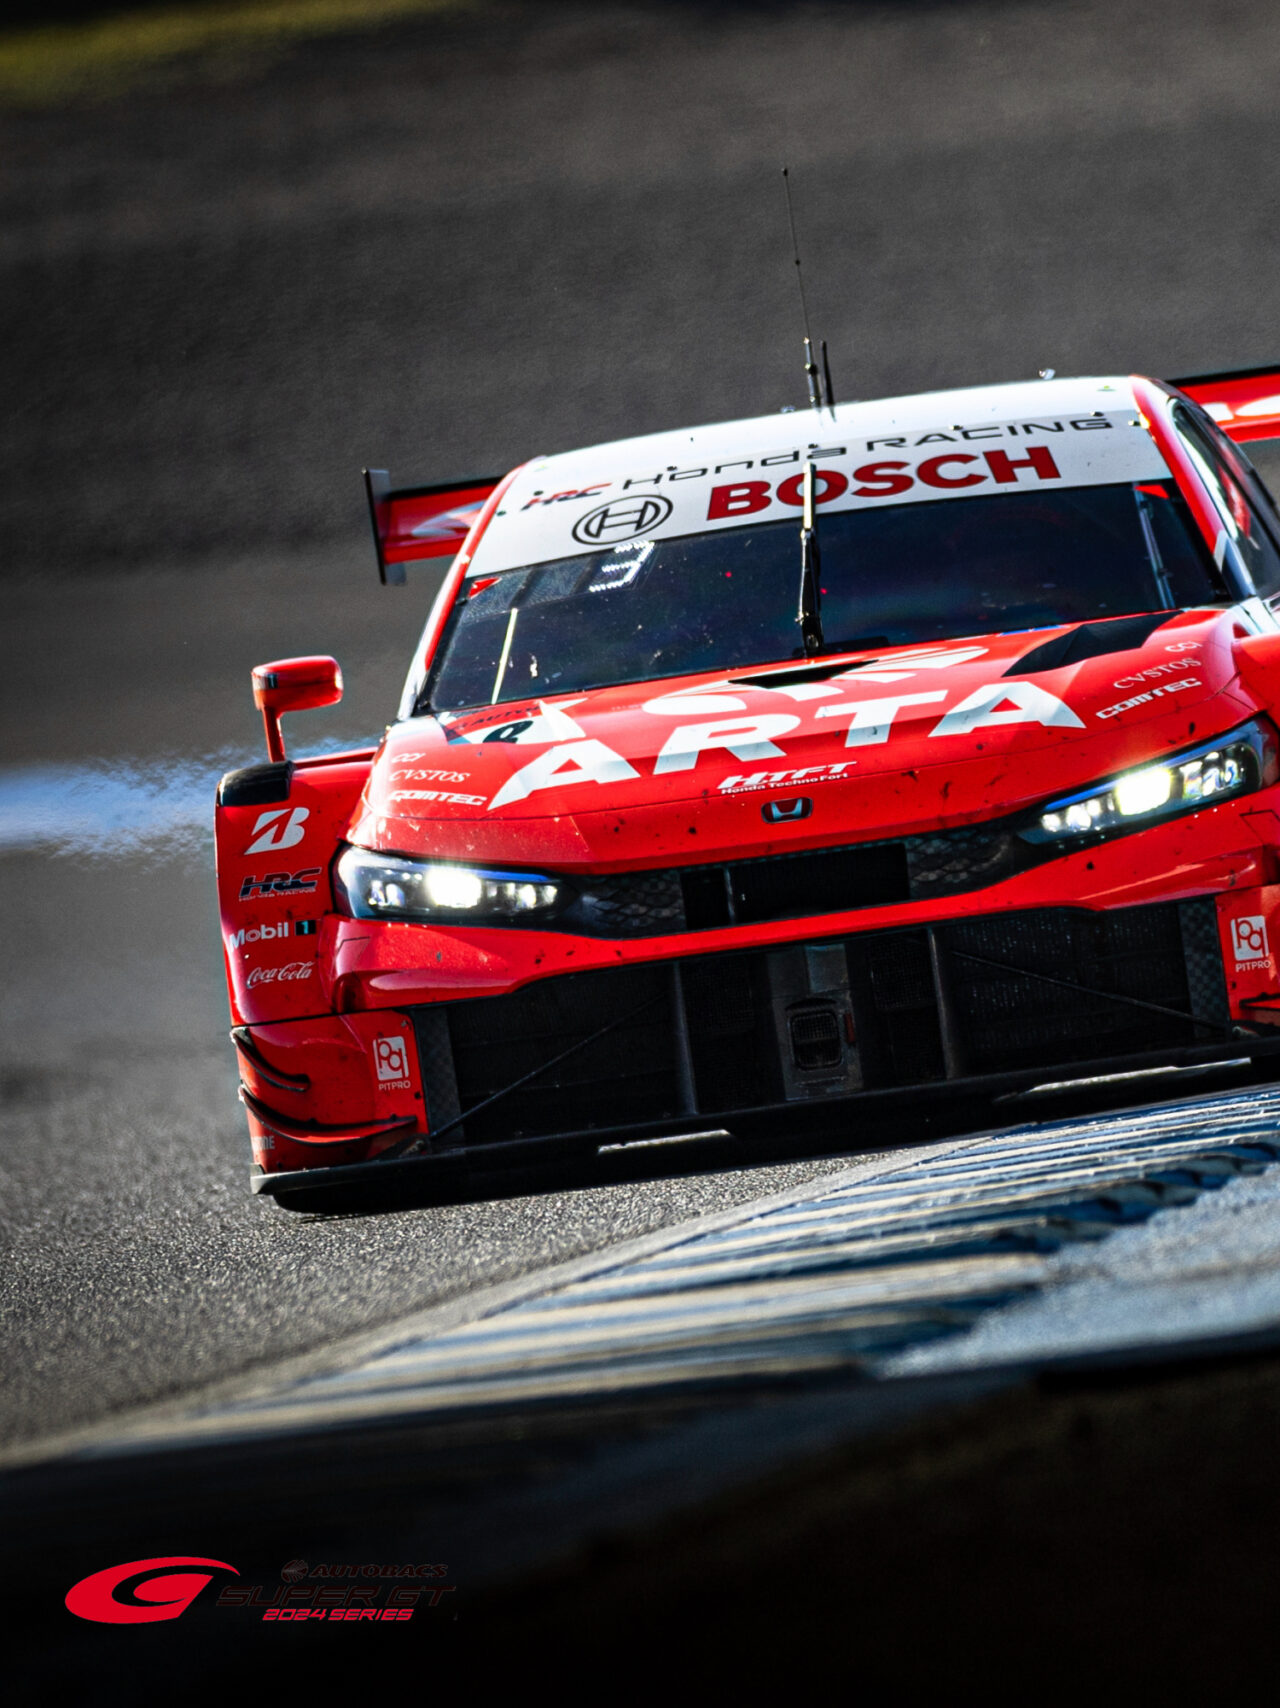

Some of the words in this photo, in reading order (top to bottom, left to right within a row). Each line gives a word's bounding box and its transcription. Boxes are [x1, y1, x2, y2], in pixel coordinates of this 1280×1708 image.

[622, 446, 848, 491] Honda
[867, 417, 1114, 452] RACING
[706, 445, 1062, 521] BOSCH
[589, 540, 654, 592] 3
[1112, 657, 1202, 689] CVSTOS
[1095, 677, 1203, 719] COMTEC
[487, 681, 1087, 810] ARTA
[389, 768, 471, 783] CVSTOS
[721, 783, 766, 795] Honda
[239, 866, 323, 898] HRC
[229, 921, 289, 953] Mobil
[1235, 960, 1272, 973] PITPRO
[378, 1080, 411, 1091] PITPRO
